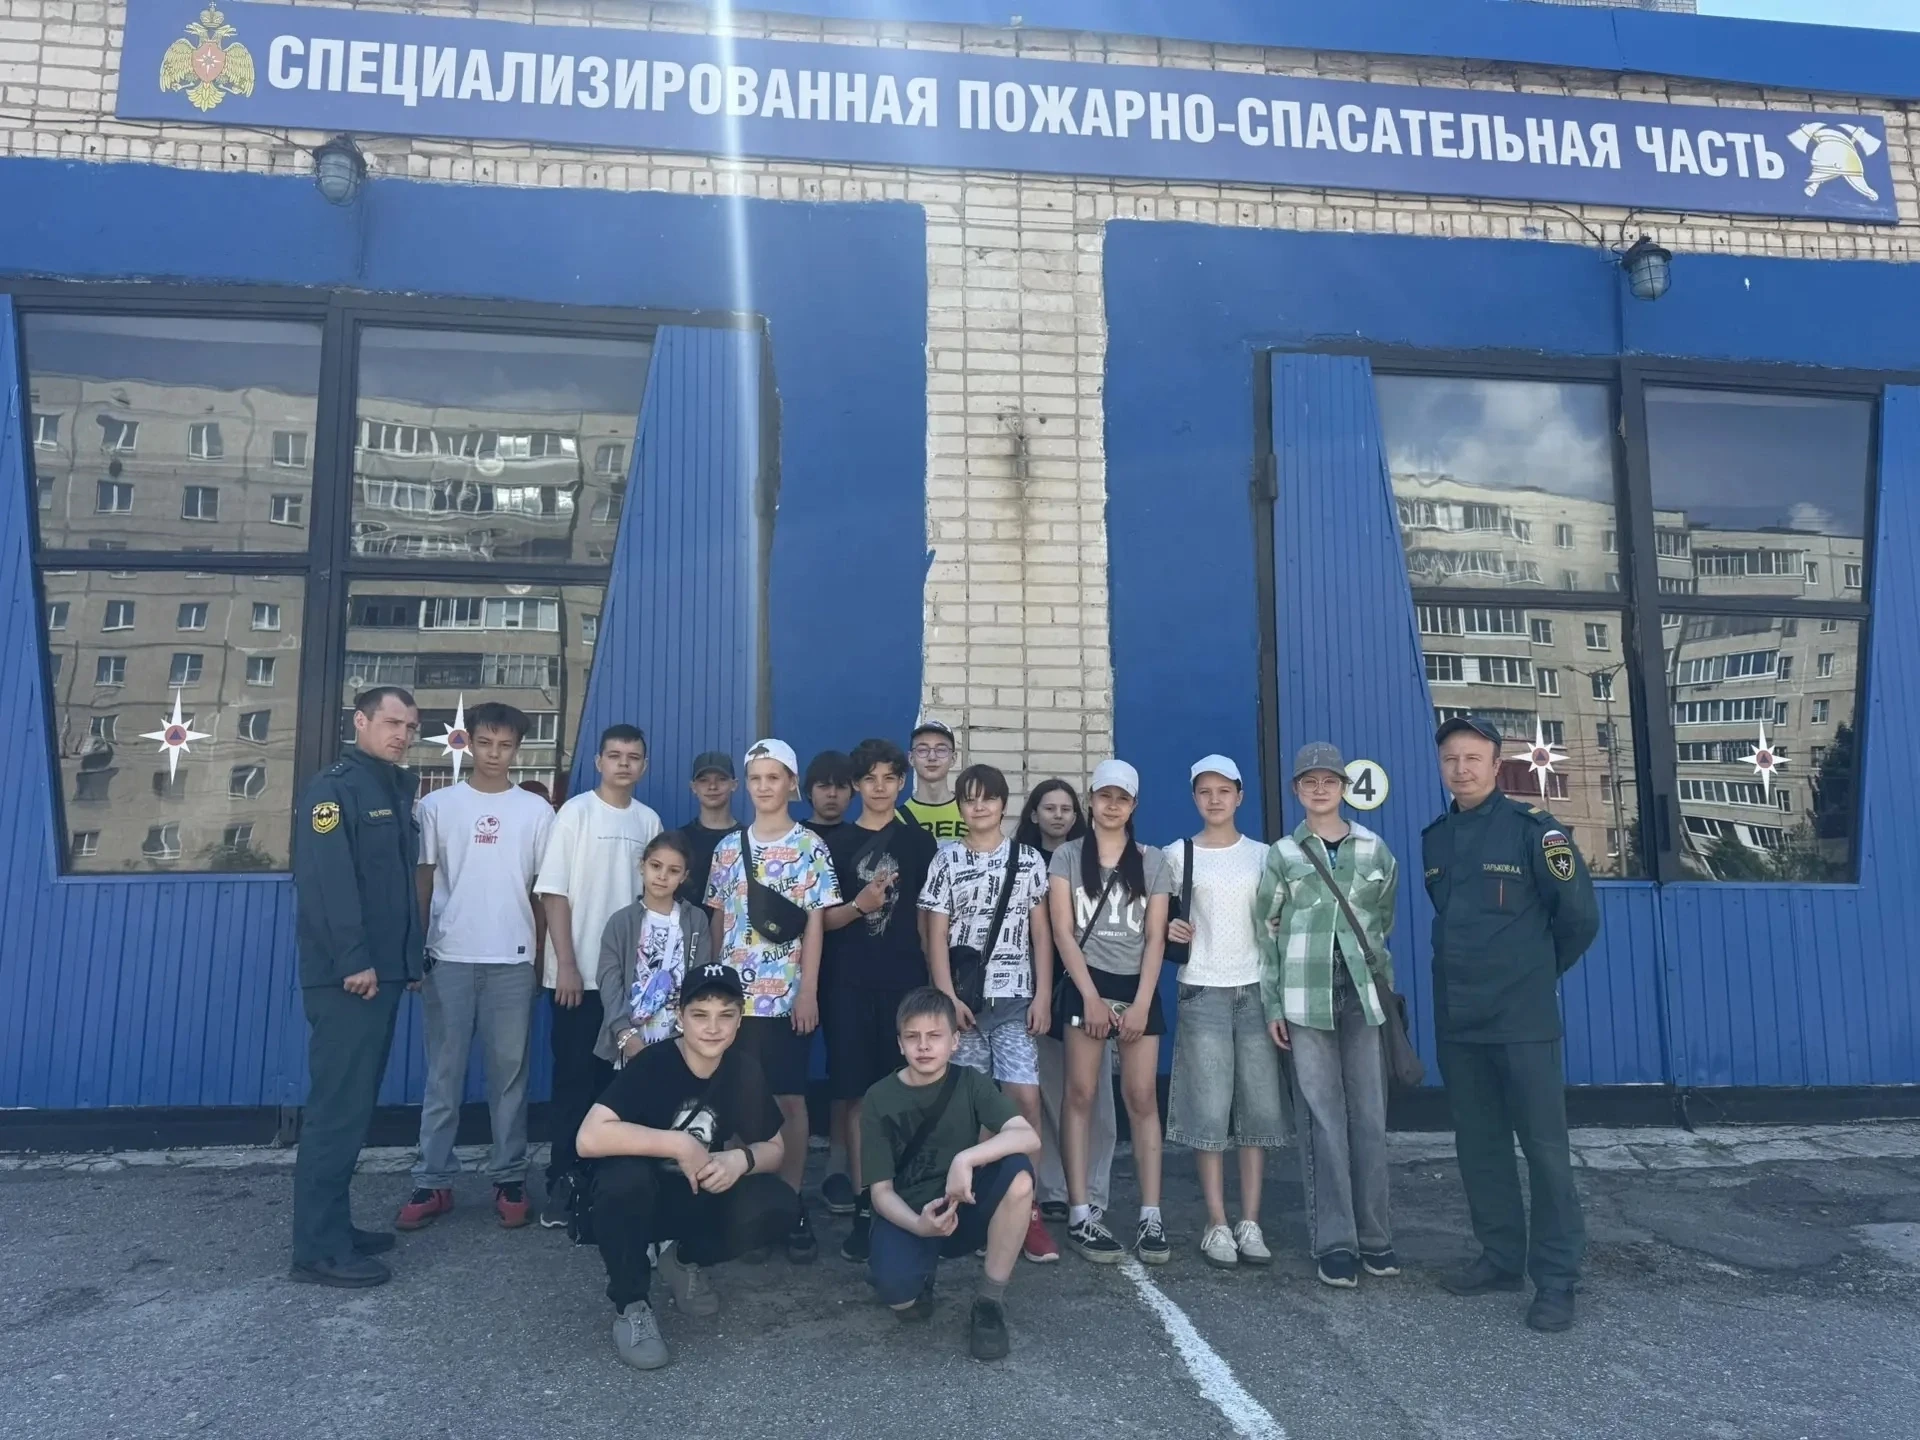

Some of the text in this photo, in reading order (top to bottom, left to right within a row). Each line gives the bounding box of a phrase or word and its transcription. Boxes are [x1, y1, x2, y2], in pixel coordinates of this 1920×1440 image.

[267, 34, 1786, 180] СПЕЦИАЛИЗИРОВАННАЯ ПОЖАРНО-СПАСАТЕЛЬНАЯ ЧАСТЬ
[1352, 767, 1376, 801] 4
